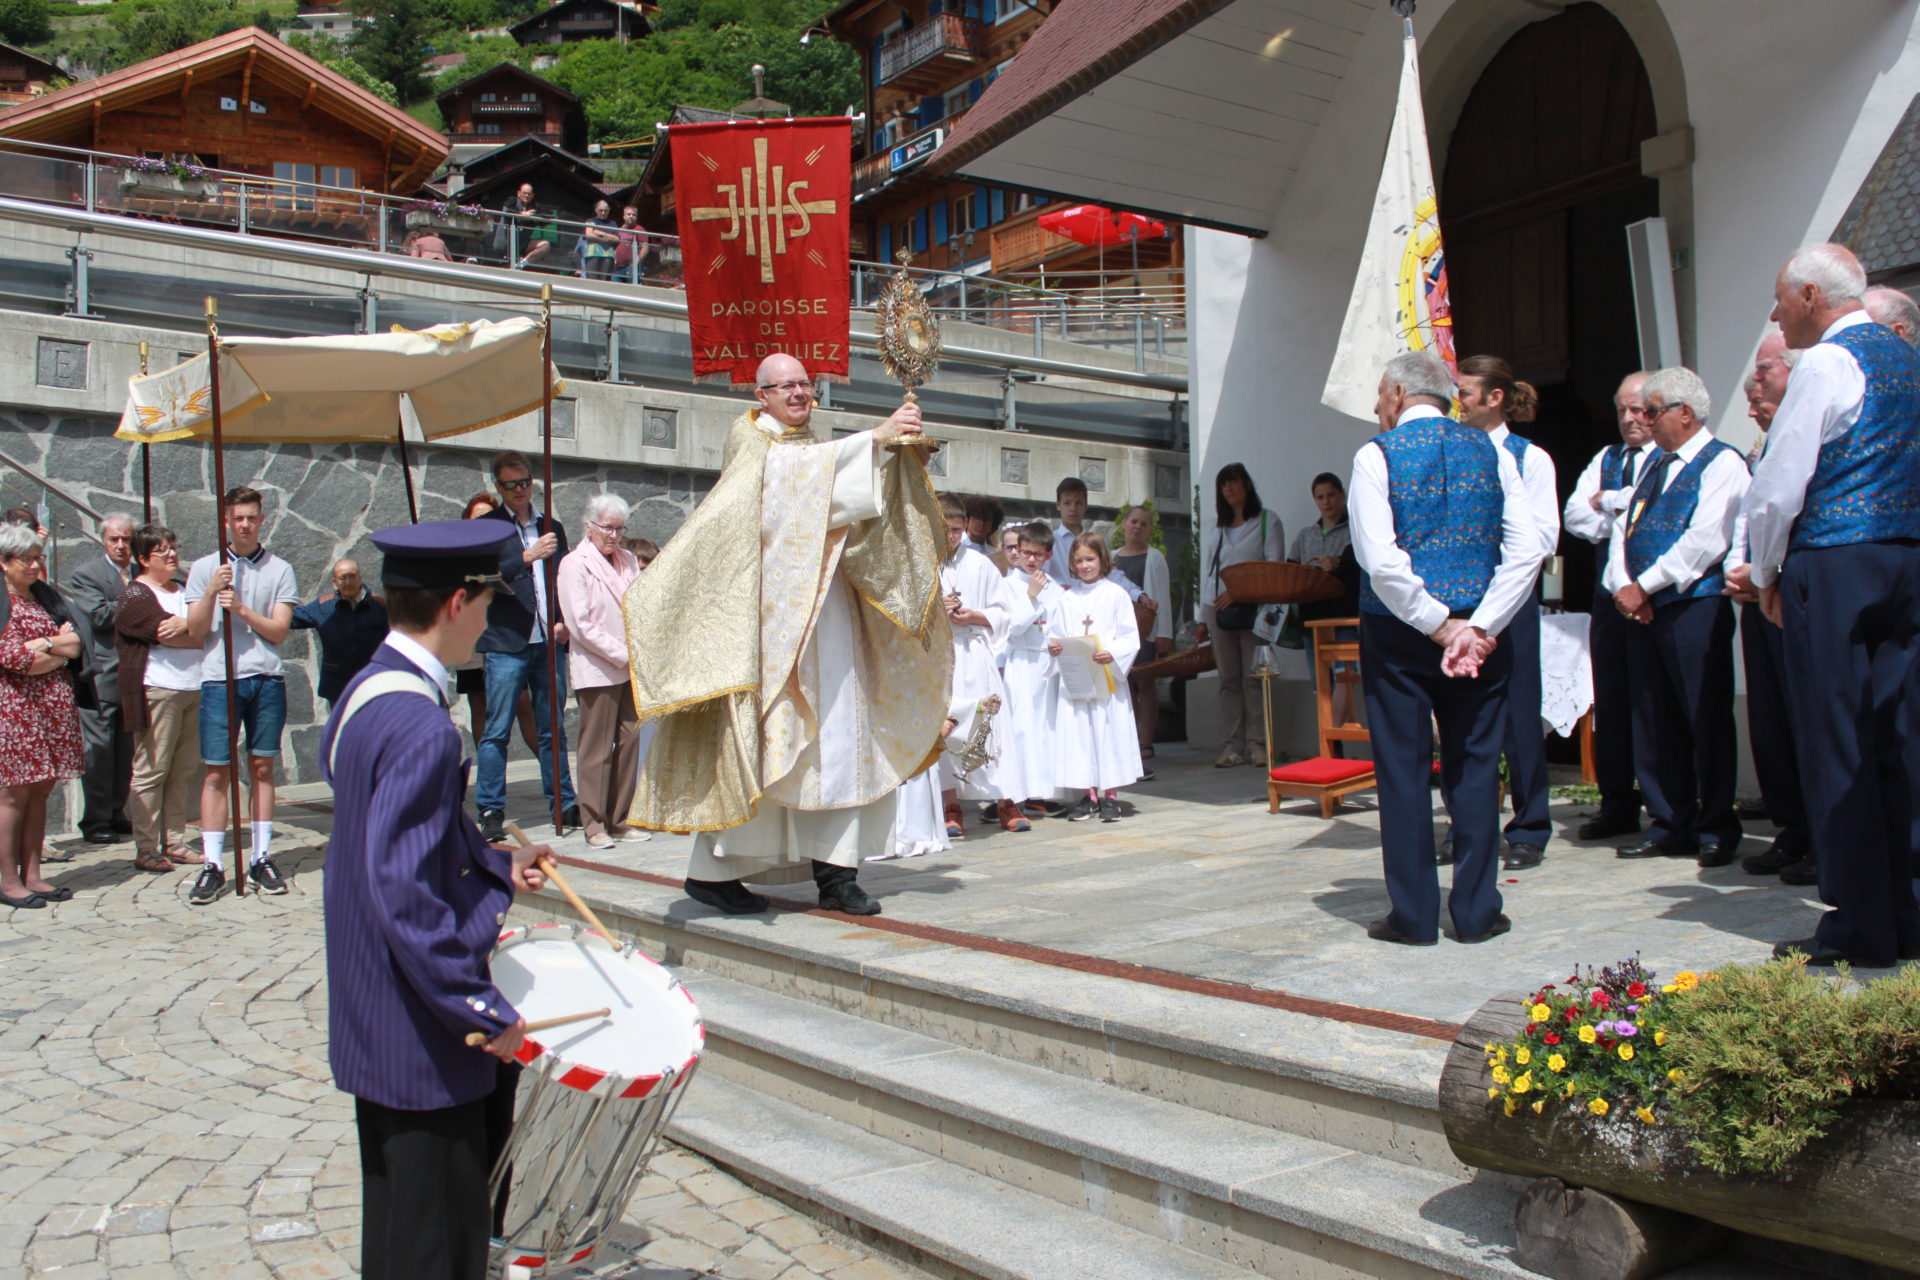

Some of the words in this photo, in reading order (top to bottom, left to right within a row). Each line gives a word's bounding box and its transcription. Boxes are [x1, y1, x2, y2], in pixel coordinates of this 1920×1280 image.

[711, 298, 828, 317] PAROISSE
[760, 322, 786, 336] DE
[703, 343, 749, 360] VAL
